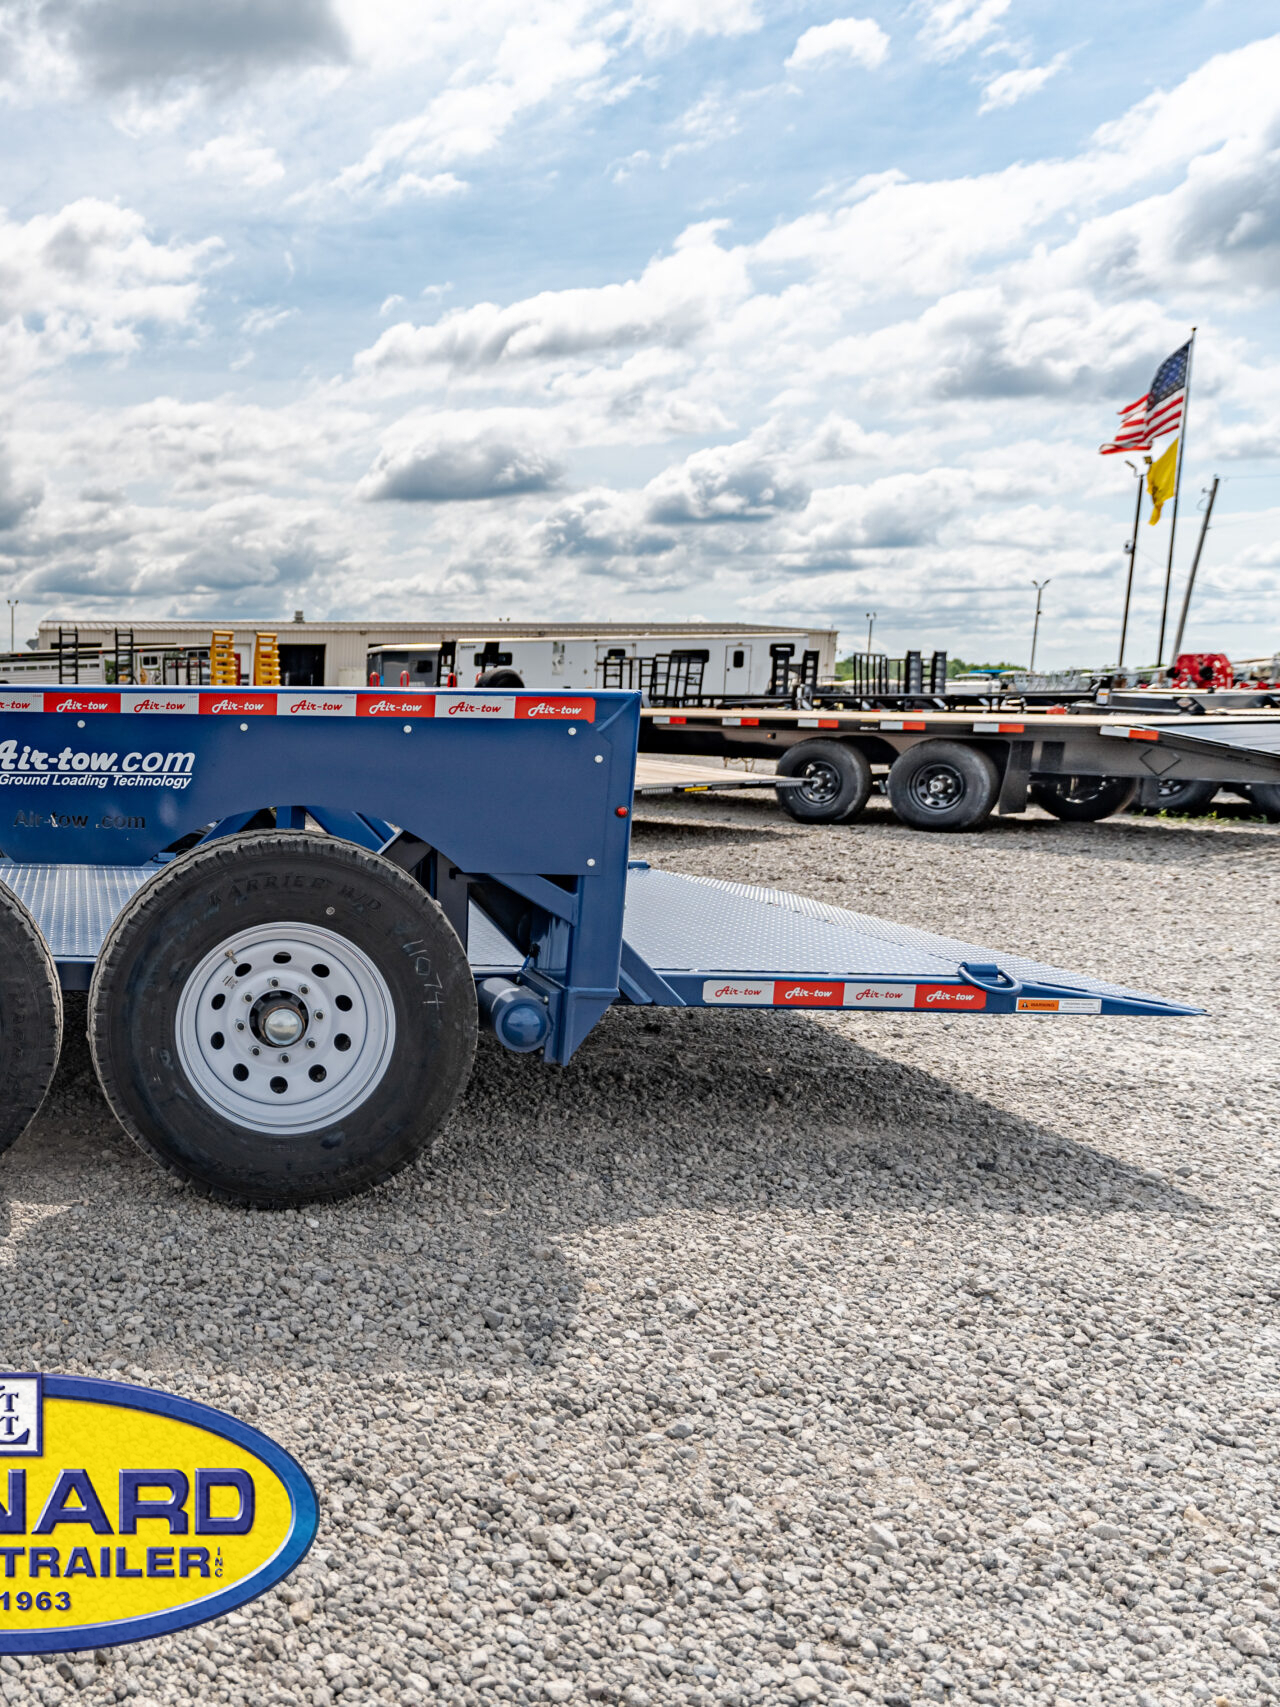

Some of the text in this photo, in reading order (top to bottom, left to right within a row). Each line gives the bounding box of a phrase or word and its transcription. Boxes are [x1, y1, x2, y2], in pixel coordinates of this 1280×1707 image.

[56, 698, 108, 712] Air-tow
[134, 699, 186, 713] Air-tow
[211, 700, 264, 713] Air-tow
[290, 700, 343, 713] Air-tow
[369, 700, 422, 714] Air-tow
[448, 701, 501, 715] Air-tow
[528, 702, 582, 716] Air-tow
[52, 774, 108, 789] Loading
[113, 774, 192, 789] Technology
[13, 808, 89, 829] Air-tow
[402, 938, 445, 1011] 11074
[715, 985, 975, 1002] Air-tow Air-tow Air-tow Air-tow
